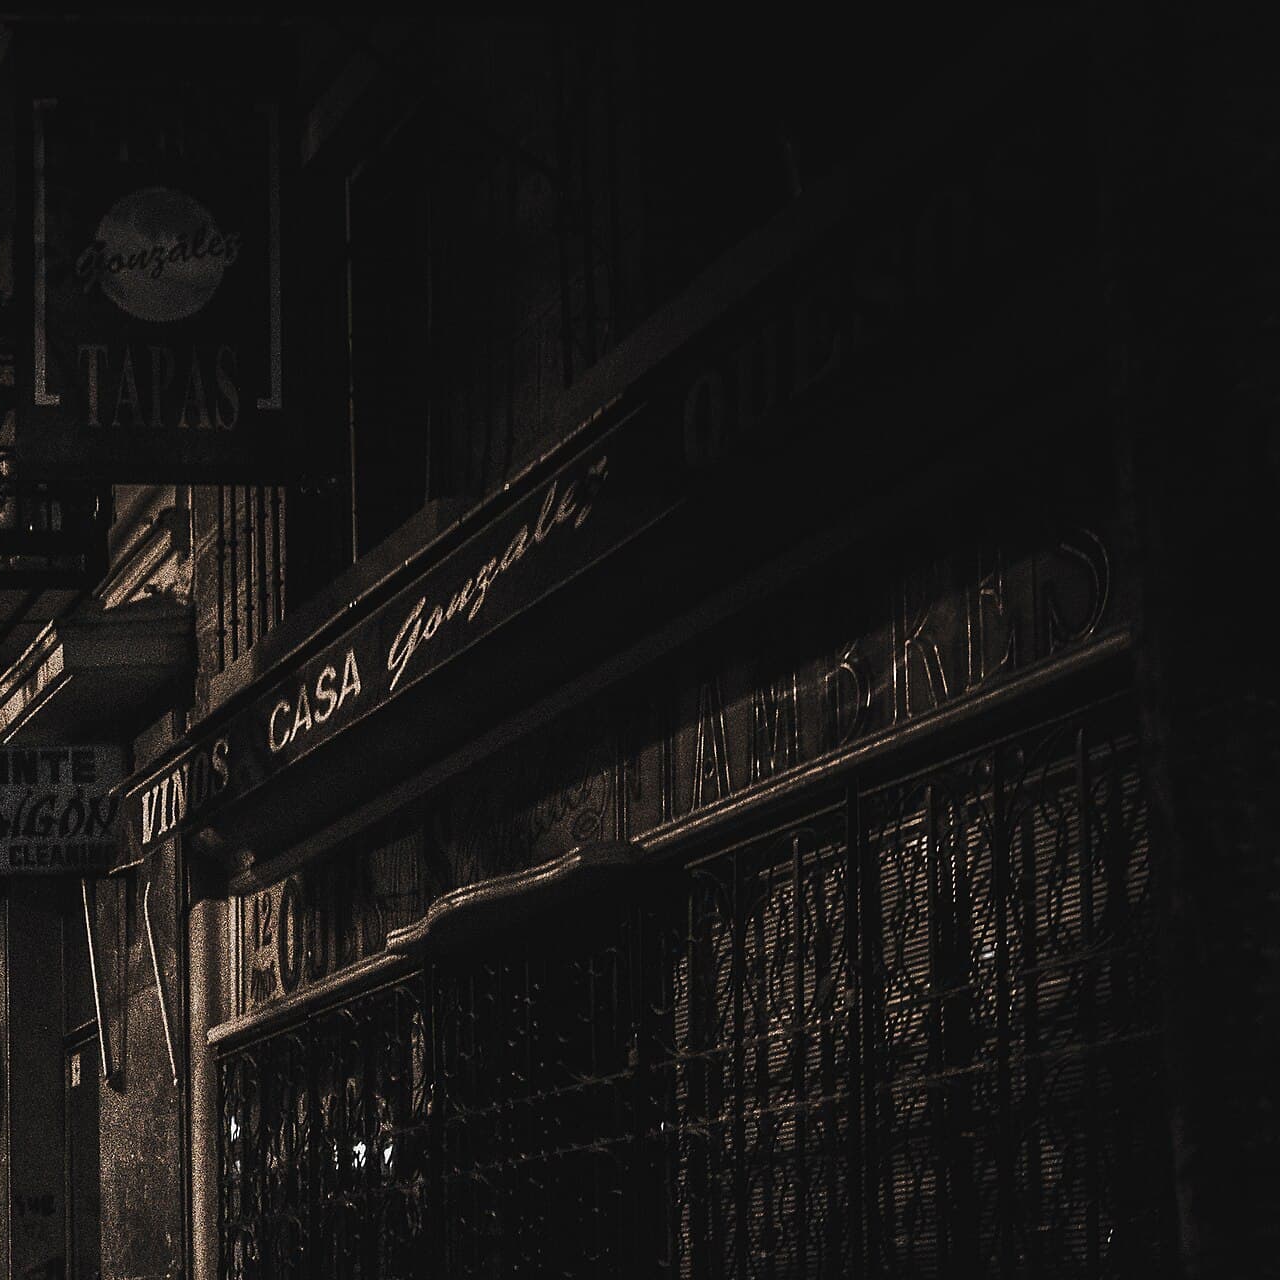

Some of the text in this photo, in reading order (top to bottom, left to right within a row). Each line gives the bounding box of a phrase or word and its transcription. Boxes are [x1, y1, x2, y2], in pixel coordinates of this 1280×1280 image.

[77, 342, 241, 433] TAPAS
[141, 738, 230, 845] VINOS
[268, 648, 362, 754] CASA
[9, 844, 117, 867] CLEANING
